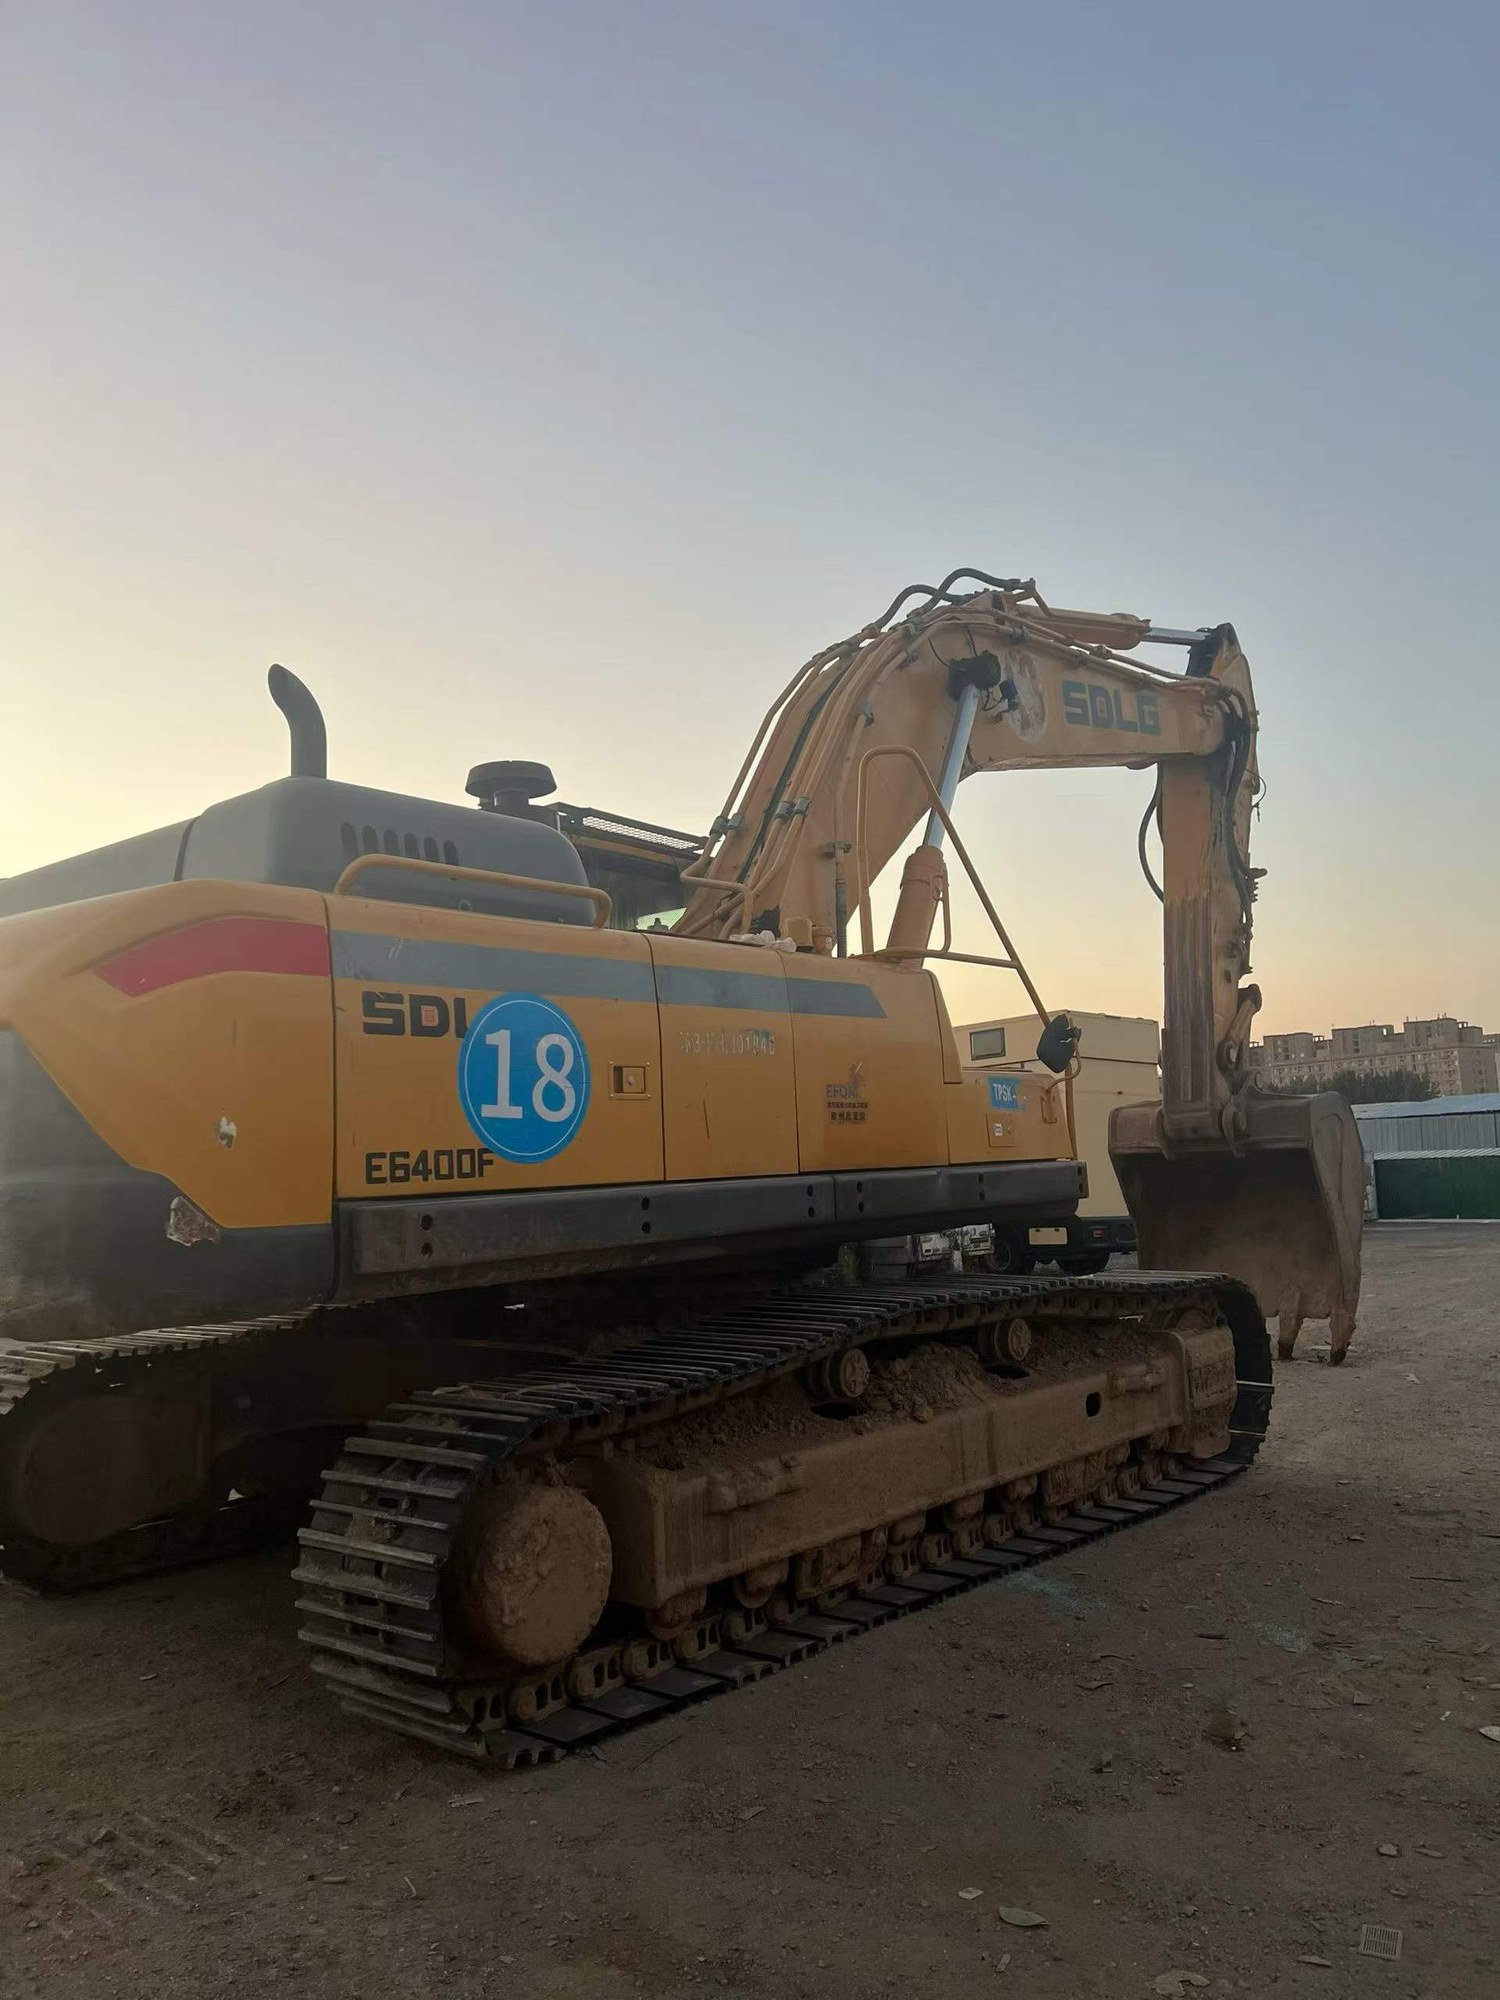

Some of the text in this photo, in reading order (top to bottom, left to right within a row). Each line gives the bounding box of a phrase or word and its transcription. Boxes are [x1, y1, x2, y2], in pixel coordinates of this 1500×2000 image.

[1062, 680, 1161, 735] SDLG
[481, 1029, 576, 1122] 18
[365, 1147, 495, 1184] E6400F
